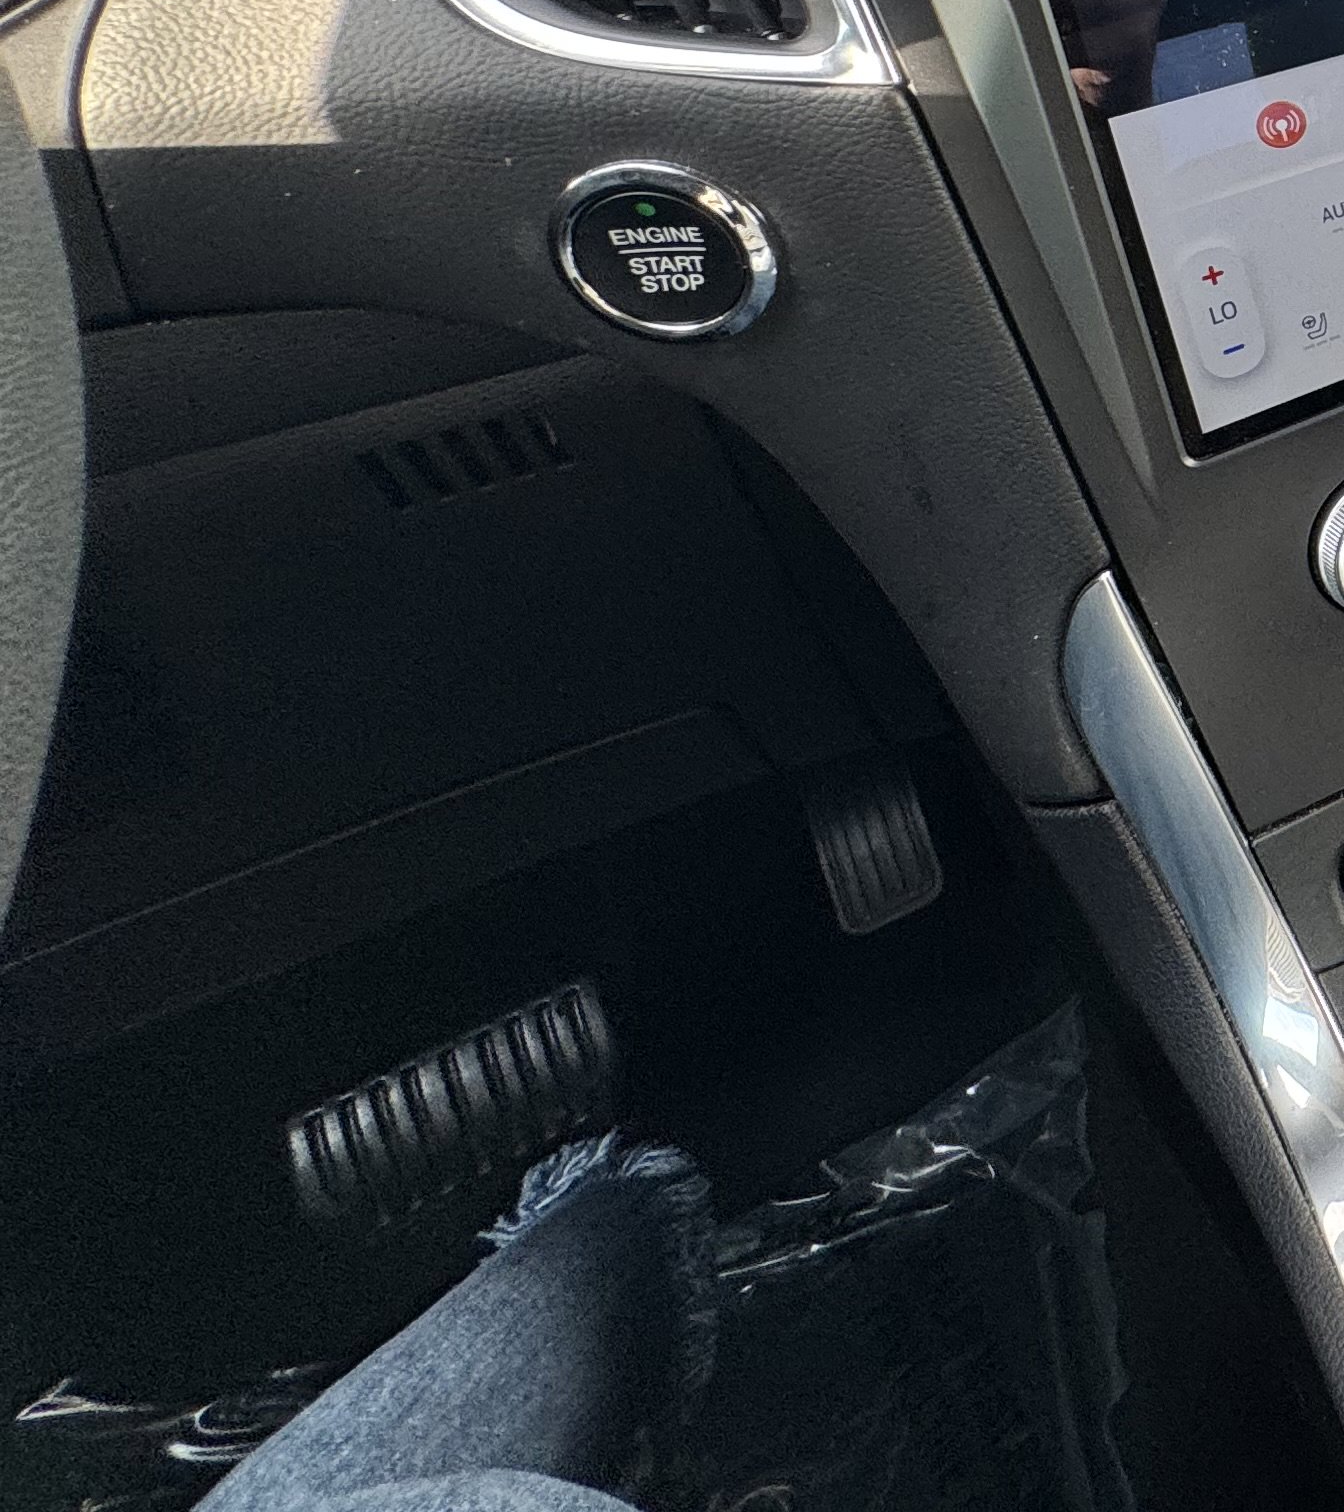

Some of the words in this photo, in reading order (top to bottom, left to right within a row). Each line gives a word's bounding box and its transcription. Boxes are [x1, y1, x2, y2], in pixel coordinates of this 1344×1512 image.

[608, 226, 705, 246] ENGINE
[628, 255, 705, 276] START
[640, 273, 705, 294] STOP
[1208, 301, 1238, 326] LO
